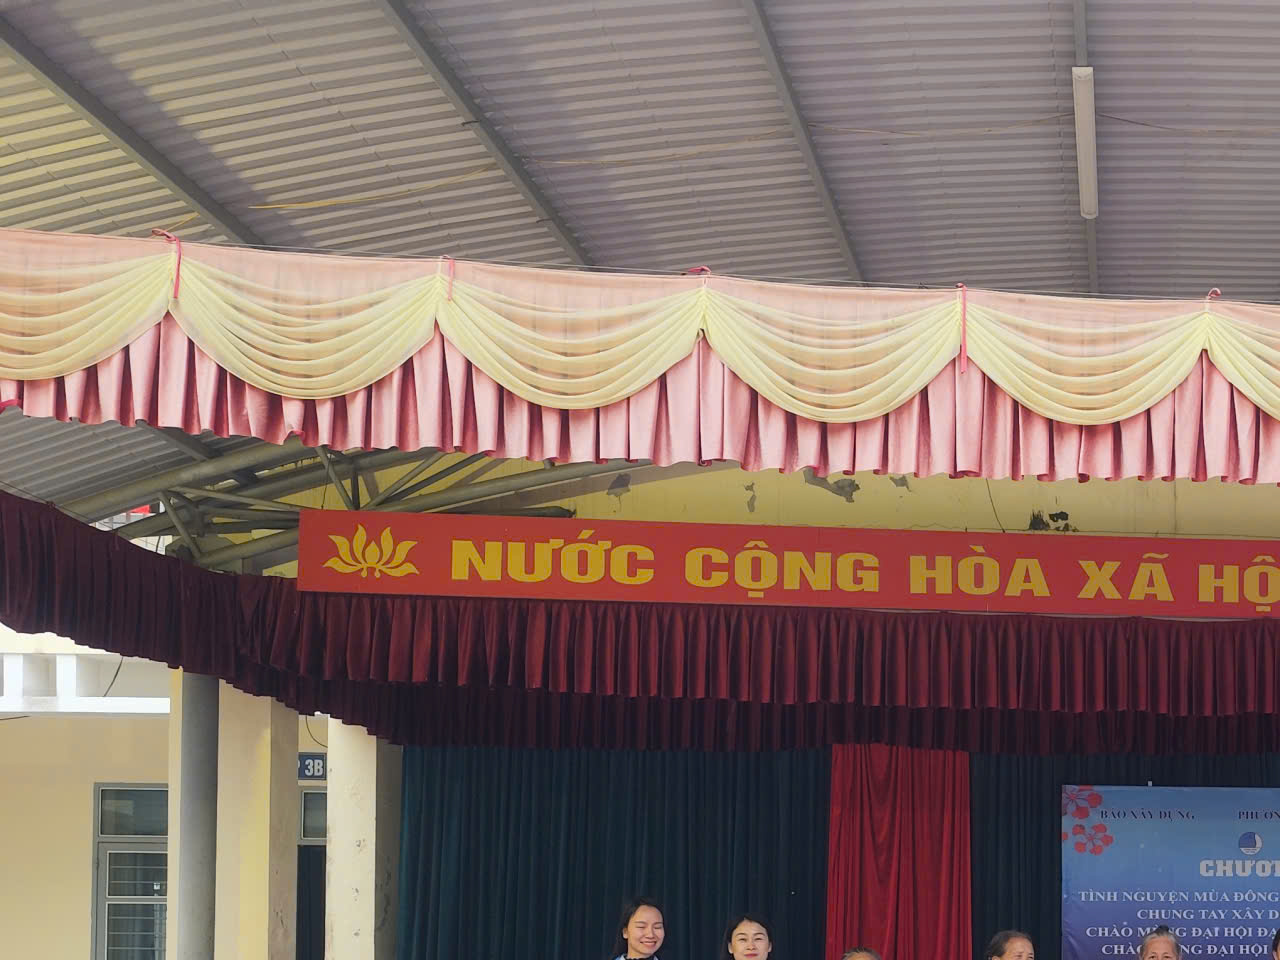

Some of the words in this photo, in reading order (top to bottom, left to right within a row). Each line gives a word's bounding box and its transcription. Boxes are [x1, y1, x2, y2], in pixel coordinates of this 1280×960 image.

[452, 530, 654, 584] NƯỚC
[685, 540, 879, 597] CỘNG
[910, 546, 1050, 597] HÒA
[1077, 553, 1175, 601] XÃ
[304, 759, 323, 776] 3B
[1159, 809, 1195, 821] DỰNG
[1079, 890, 1117, 902] TÌNH
[1122, 889, 1191, 904] NGUYỆN
[1194, 890, 1230, 902] MÙA
[1233, 889, 1279, 902] ĐÔNG
[1137, 909, 1194, 920] CHUNG
[1199, 909, 1230, 920] TAY
[1232, 906, 1265, 920] XÂY
[1086, 924, 1133, 937] CHÀO
[1191, 927, 1219, 939] ĐẠI
[1224, 926, 1252, 939] HỘI
[1206, 945, 1233, 957] ĐẠI
[1239, 943, 1268, 957] HỘI
